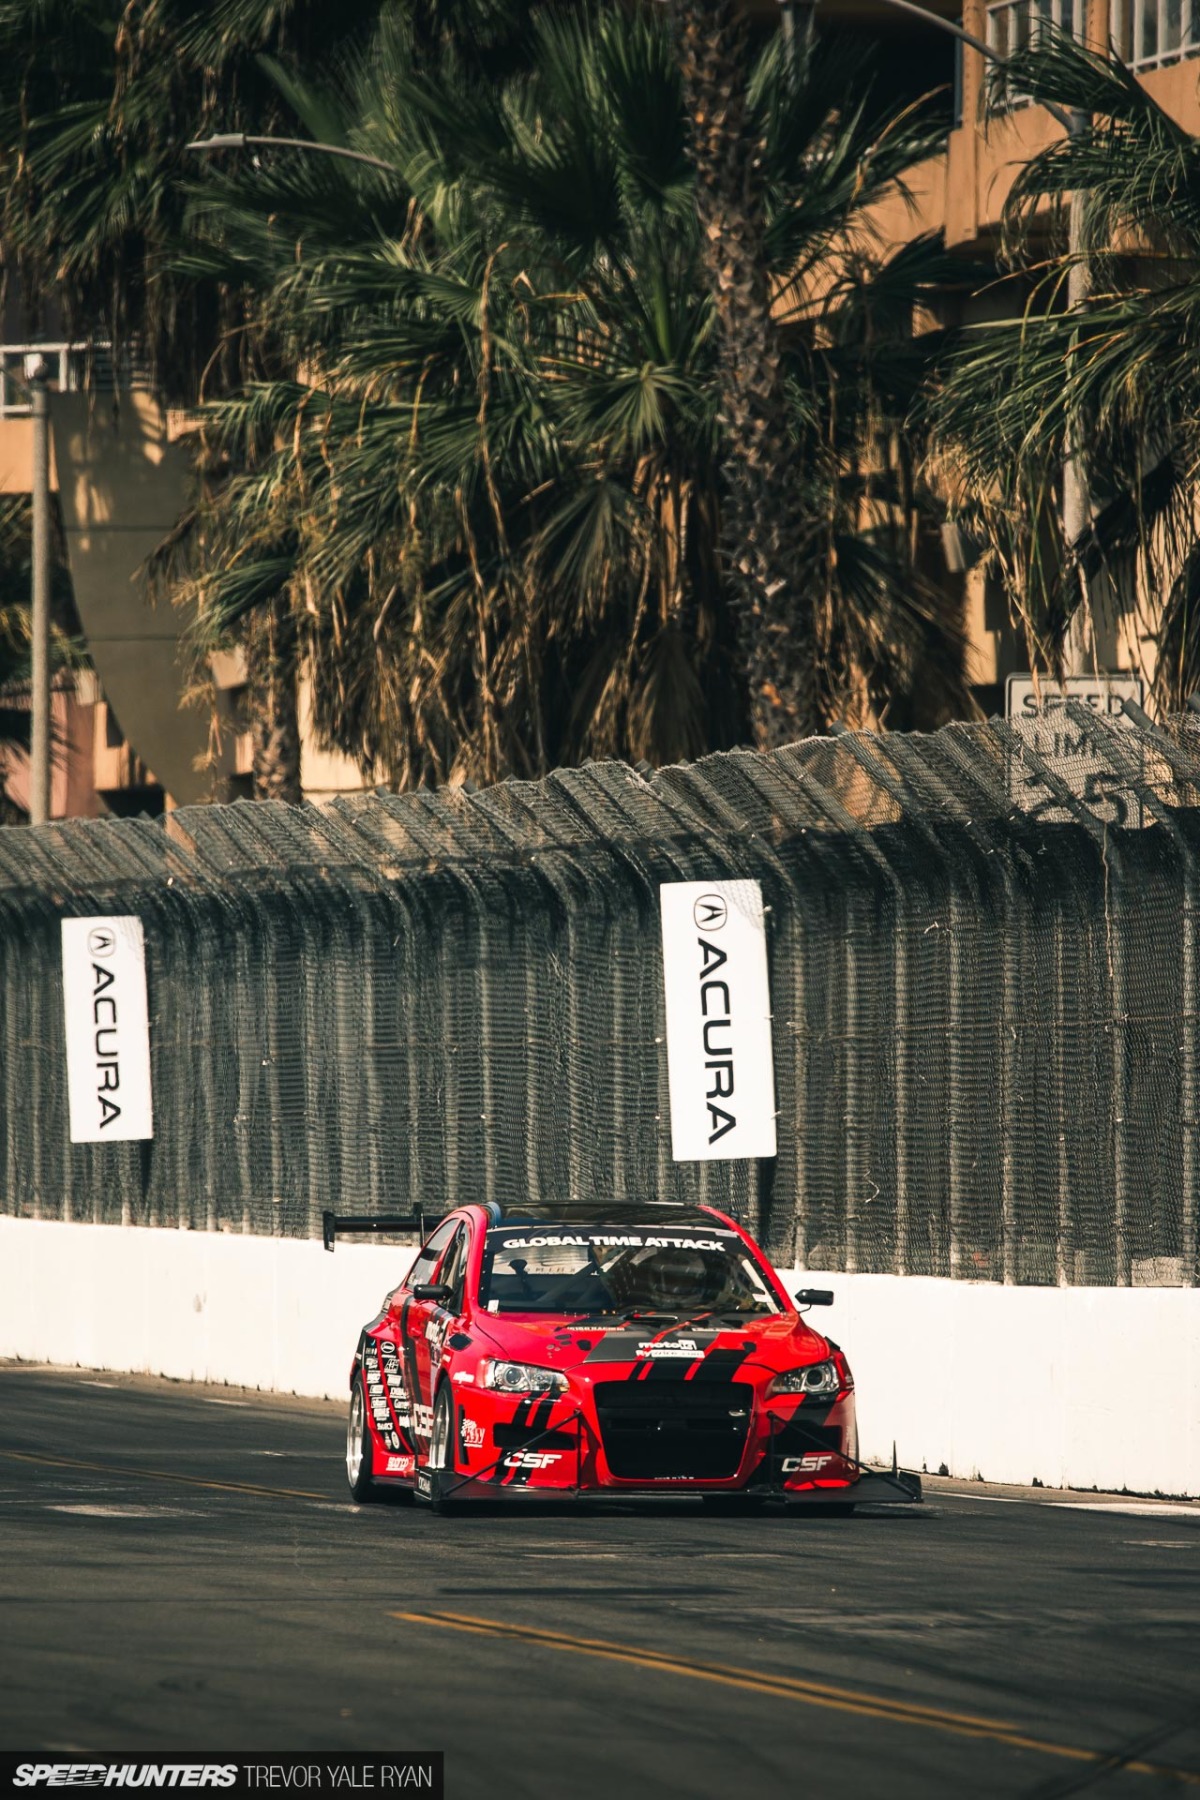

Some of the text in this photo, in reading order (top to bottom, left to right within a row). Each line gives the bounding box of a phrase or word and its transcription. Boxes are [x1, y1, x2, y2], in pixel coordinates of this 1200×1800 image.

[92, 963, 122, 1129] ACURA
[698, 937, 736, 1145] ACURA
[503, 1235, 726, 1252] GLOBAL TIME ATTACK
[504, 1453, 563, 1469] CSF
[781, 1456, 833, 1472] CSF
